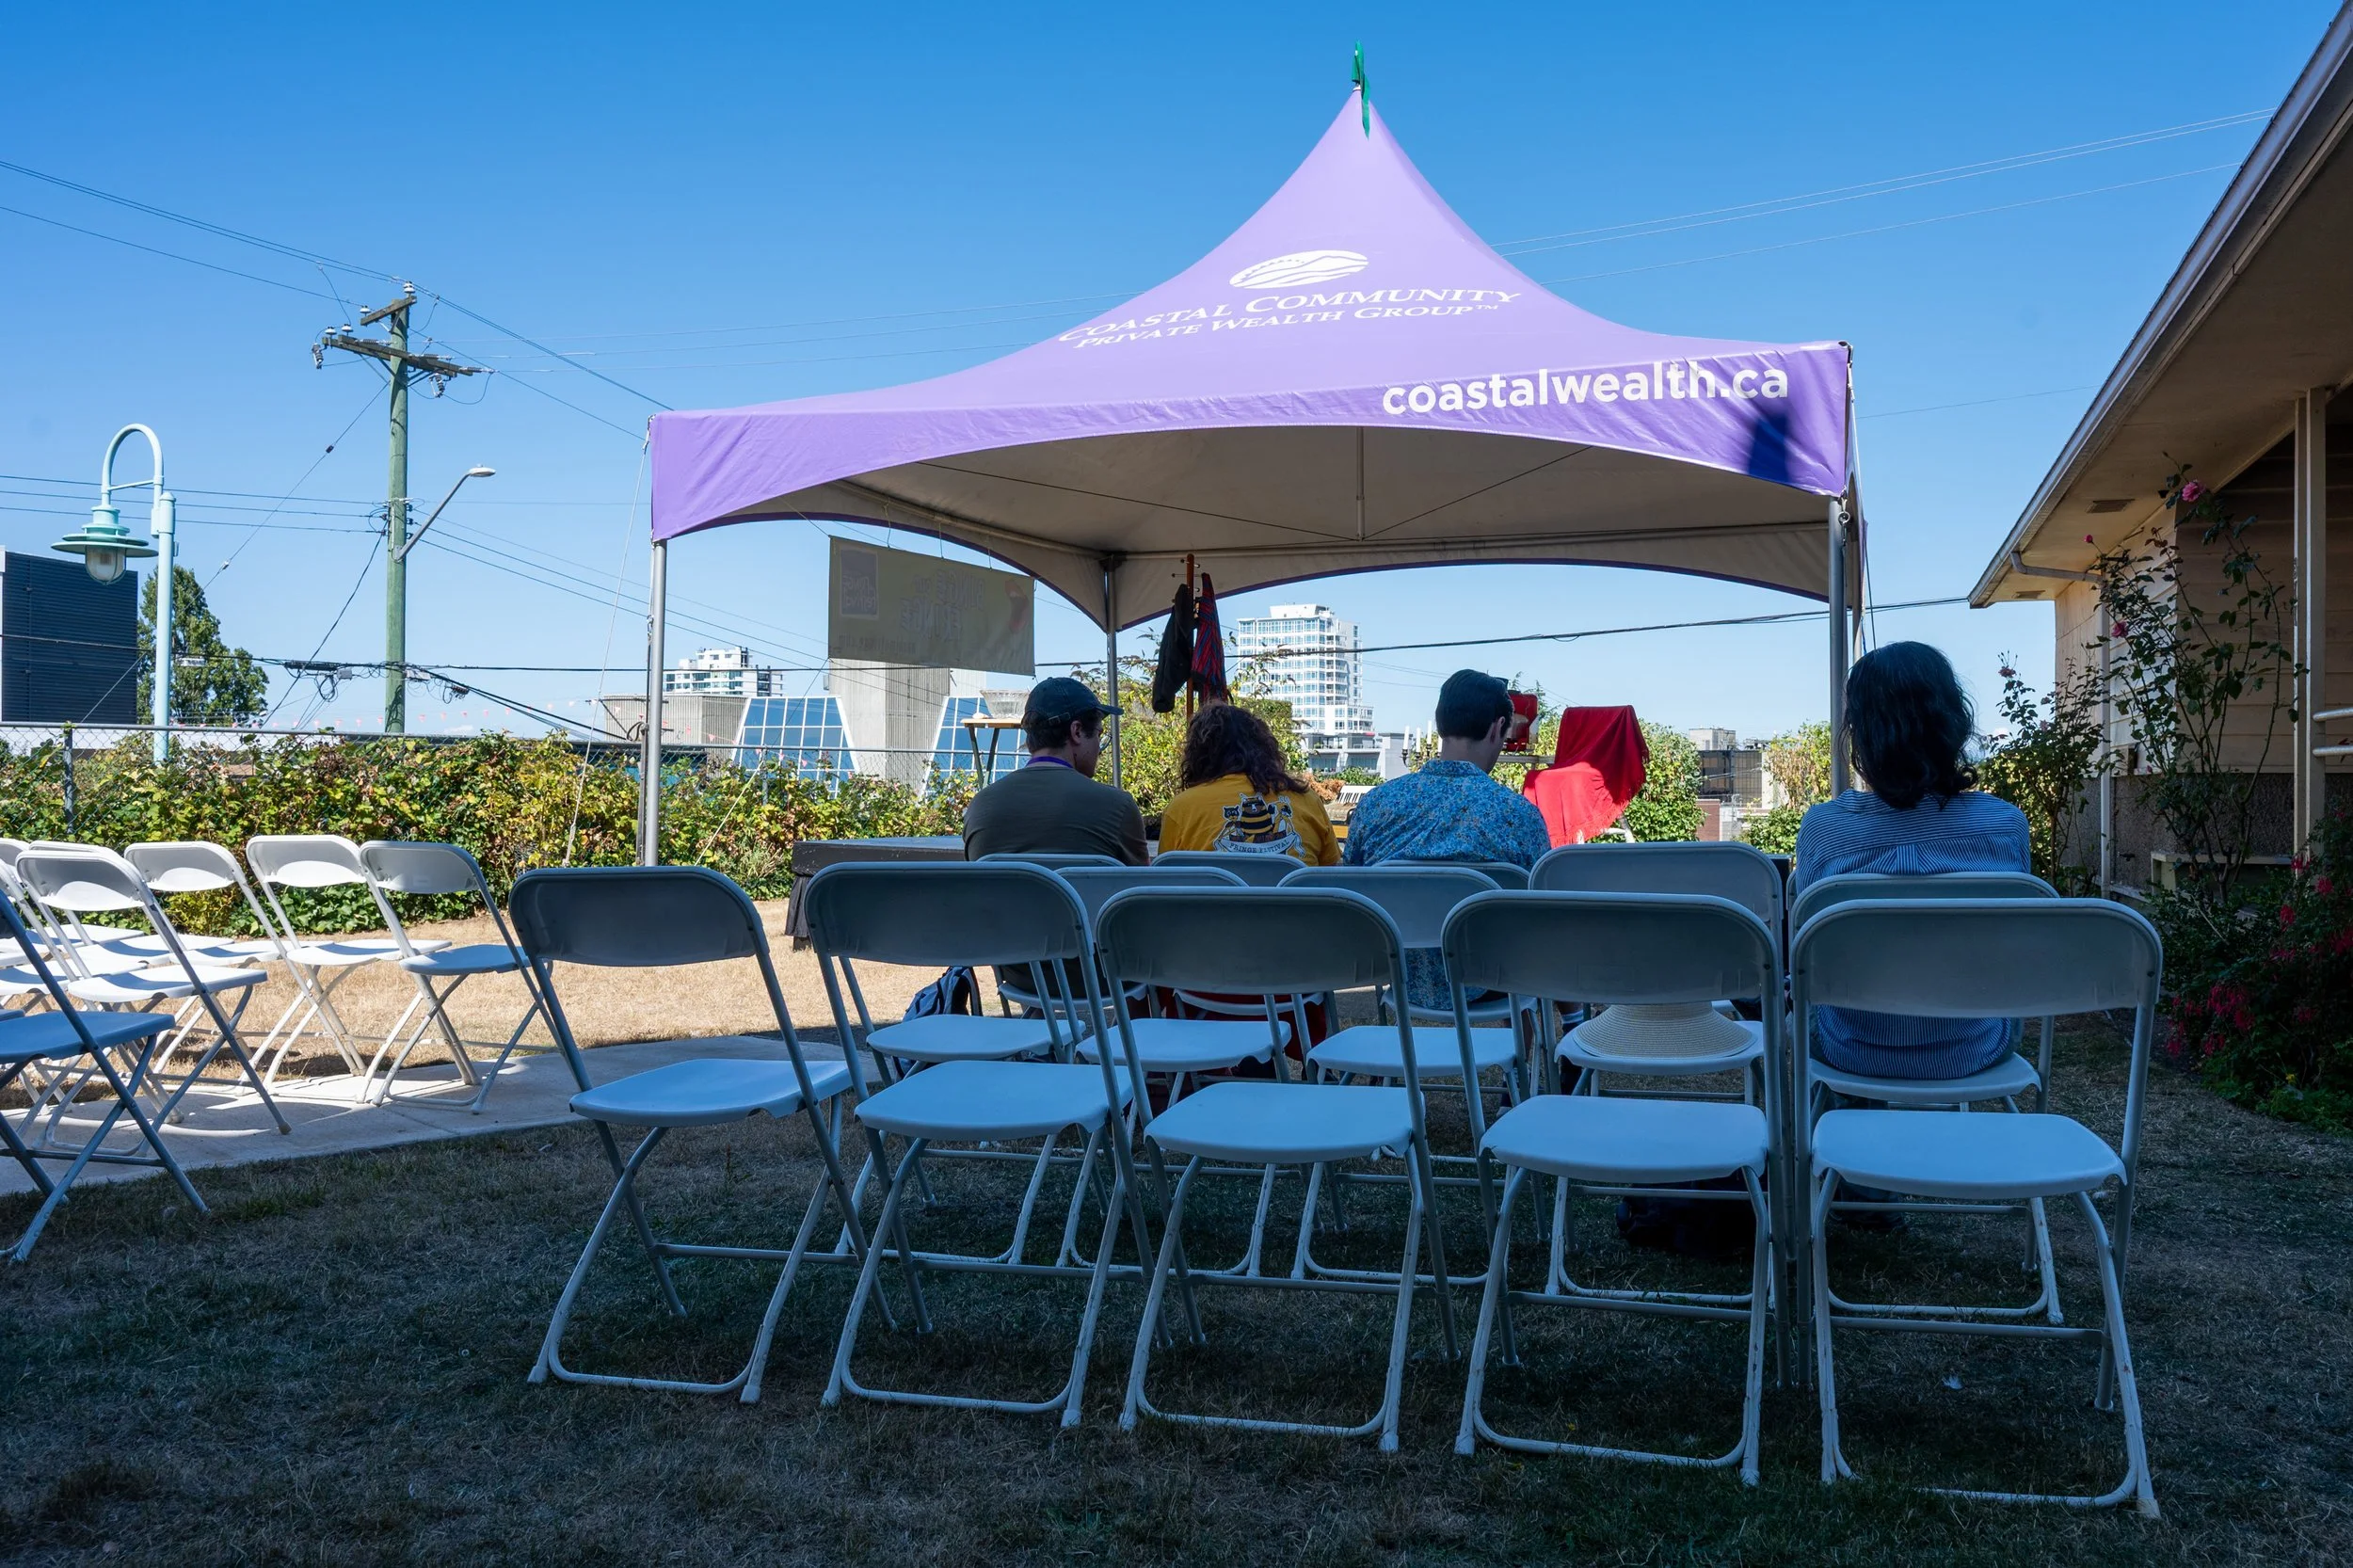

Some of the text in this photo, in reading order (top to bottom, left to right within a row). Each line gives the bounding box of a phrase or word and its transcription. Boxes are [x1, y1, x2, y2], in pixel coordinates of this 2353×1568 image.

[1058, 288, 1521, 343] COASTAL COMMUNITY
[1073, 323, 1200, 348] PRIVATE
[1211, 310, 1344, 332] WEALTH
[1382, 360, 1789, 415] coastalwealth.ca
[1229, 842, 1257, 853] FRINGE
